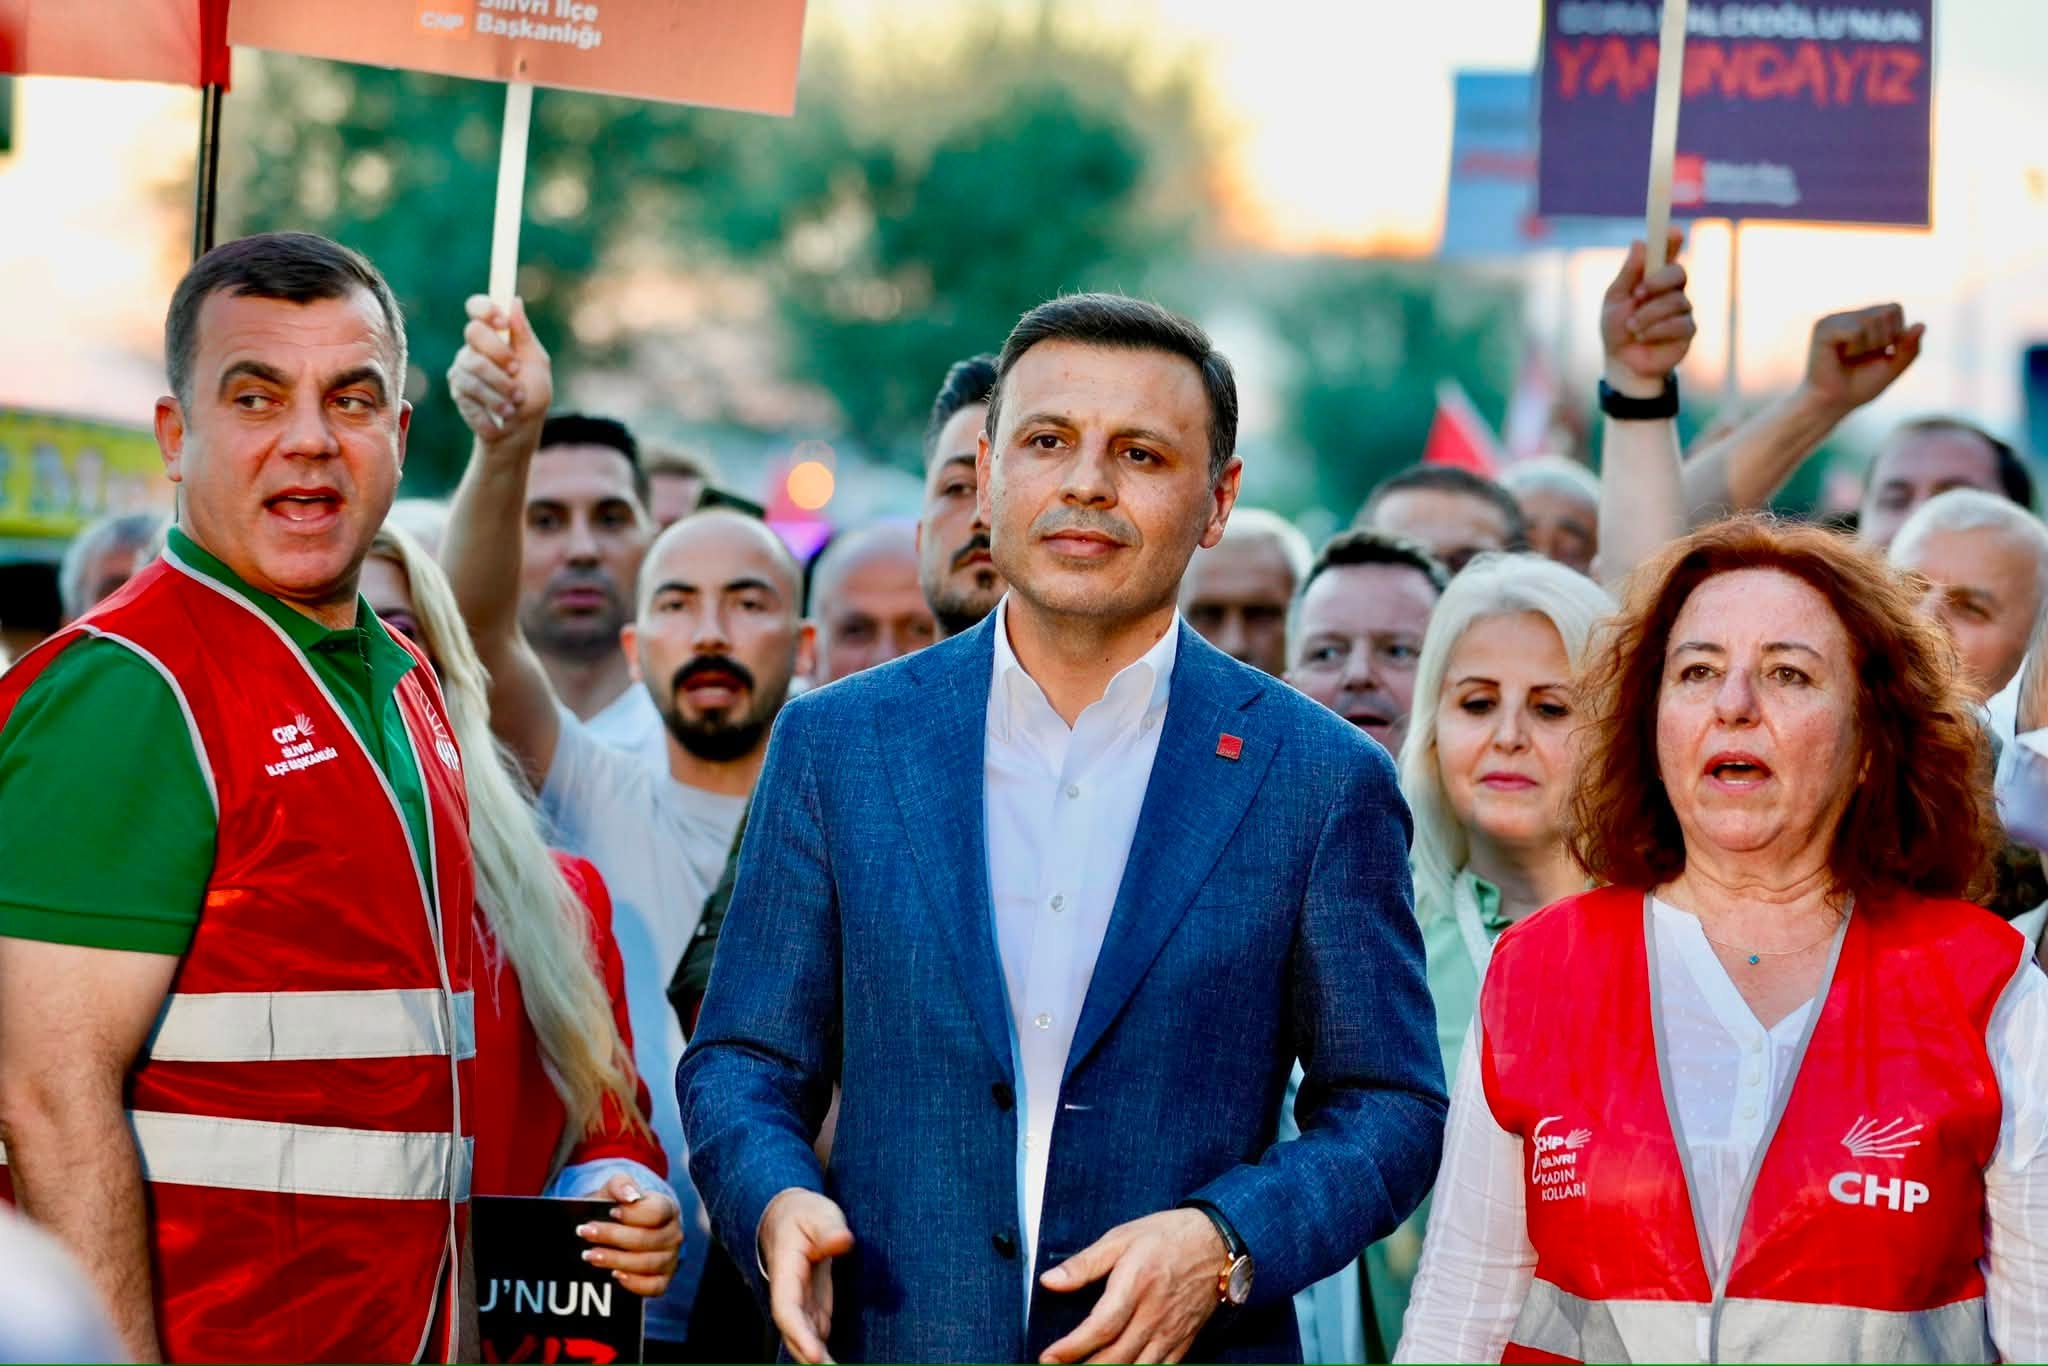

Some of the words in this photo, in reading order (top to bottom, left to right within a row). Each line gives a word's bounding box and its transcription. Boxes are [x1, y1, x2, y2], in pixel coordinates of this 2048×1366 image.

[476, 12, 602, 49] Başkanlığı
[272, 724, 298, 744] CHP
[1541, 1167, 1575, 1186] KADIN
[1541, 1182, 1586, 1202] KOLLARI
[1828, 1171, 1930, 1213] CHP
